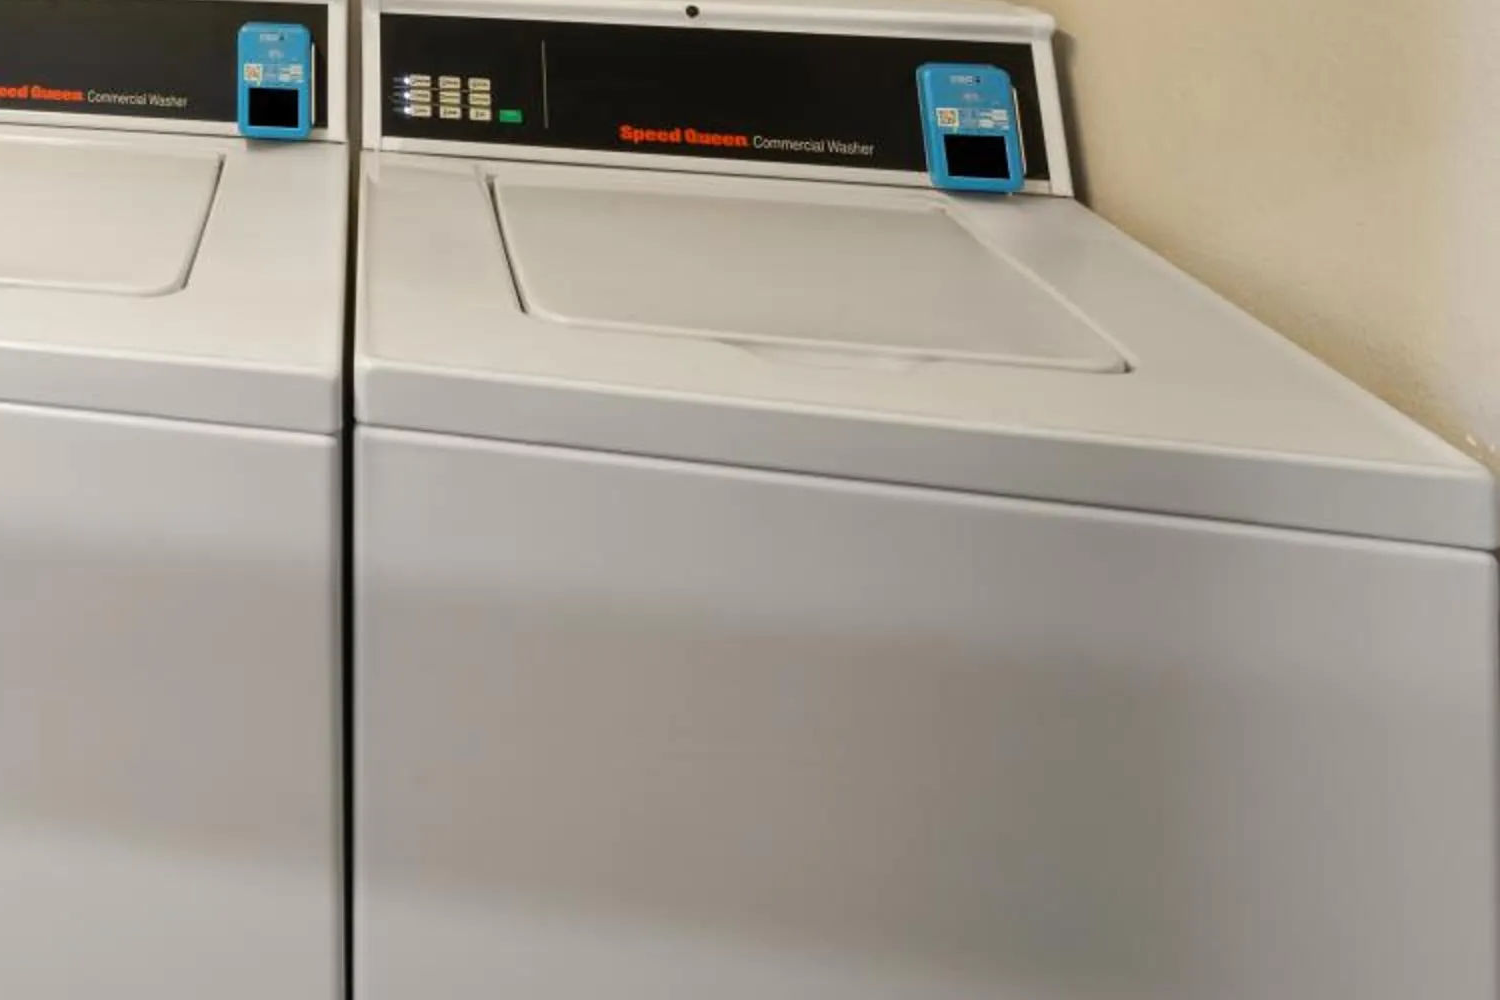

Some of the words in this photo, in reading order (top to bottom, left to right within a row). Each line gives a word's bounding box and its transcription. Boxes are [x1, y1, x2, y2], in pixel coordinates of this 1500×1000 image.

[31, 85, 83, 101] Queen
[87, 89, 147, 105] Commercial
[149, 93, 188, 107] Washer
[619, 124, 681, 145] Speed
[684, 127, 748, 147] Queen
[752, 135, 825, 153] Commercial
[827, 140, 875, 156] Washer
